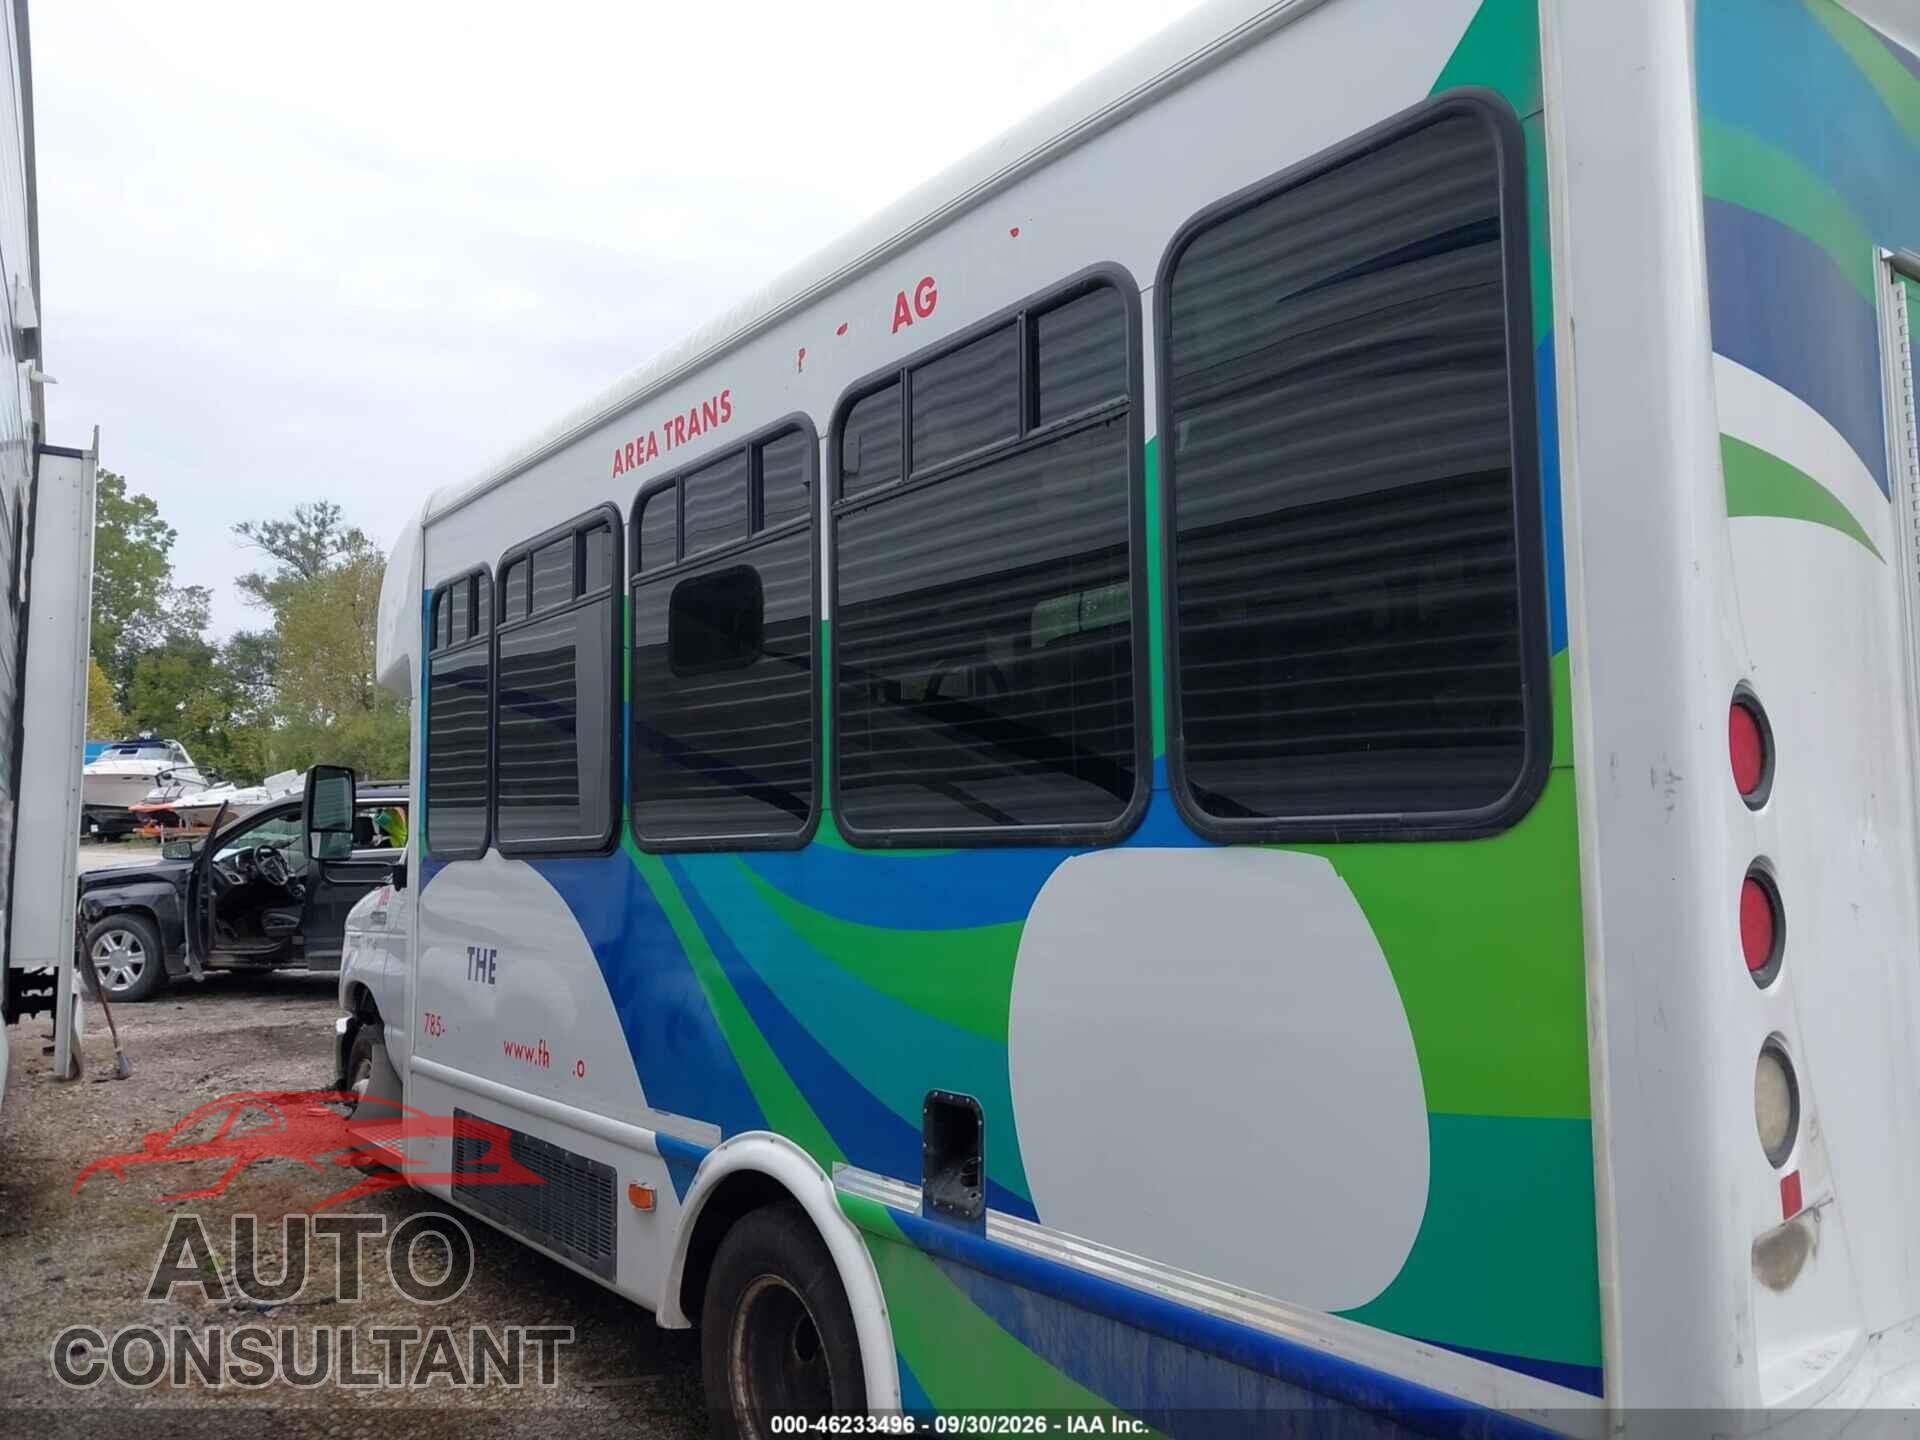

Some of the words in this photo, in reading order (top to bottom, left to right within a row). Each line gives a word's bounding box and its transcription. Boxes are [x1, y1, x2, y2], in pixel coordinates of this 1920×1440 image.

[613, 430, 659, 479] AREA
[663, 389, 732, 451] TRANS
[892, 276, 938, 334] AG
[467, 947, 498, 984] THE
